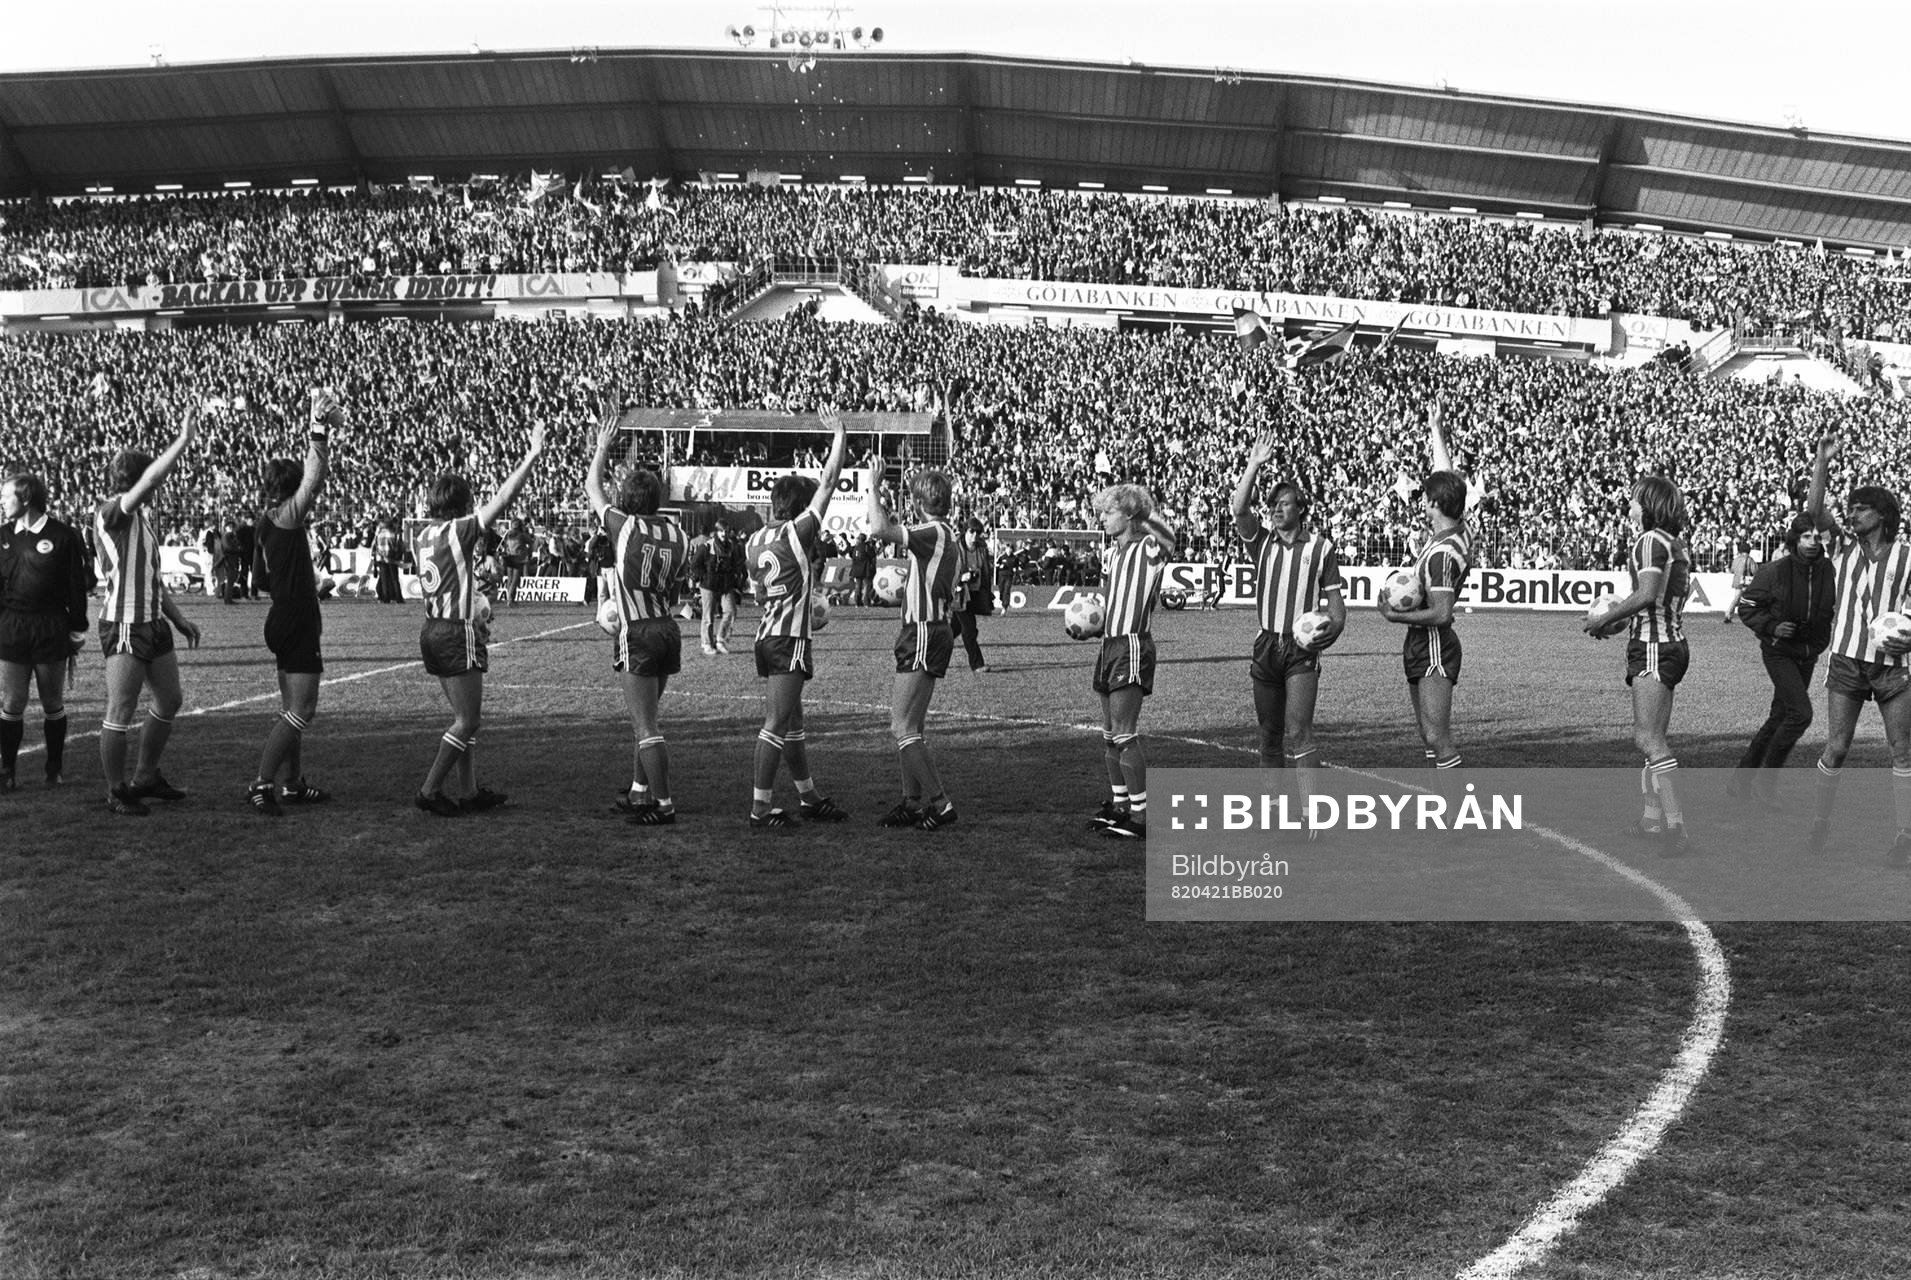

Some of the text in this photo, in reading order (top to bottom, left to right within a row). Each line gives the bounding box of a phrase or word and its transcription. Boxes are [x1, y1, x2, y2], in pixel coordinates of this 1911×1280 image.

[265, 279, 307, 303] UPP
[405, 274, 496, 299] IDROTT!
[518, 274, 564, 296] ICA
[905, 271, 930, 284] OK
[82, 288, 132, 312] ICA
[1027, 284, 1177, 308] GÖTABANKEN
[1215, 294, 1366, 320] GÖTABANKEN
[1409, 308, 1568, 336] GÖTABANKEN
[827, 515, 862, 532] OK
[419, 545, 441, 593] 5
[640, 544, 672, 592] 11
[757, 551, 787, 597] 2
